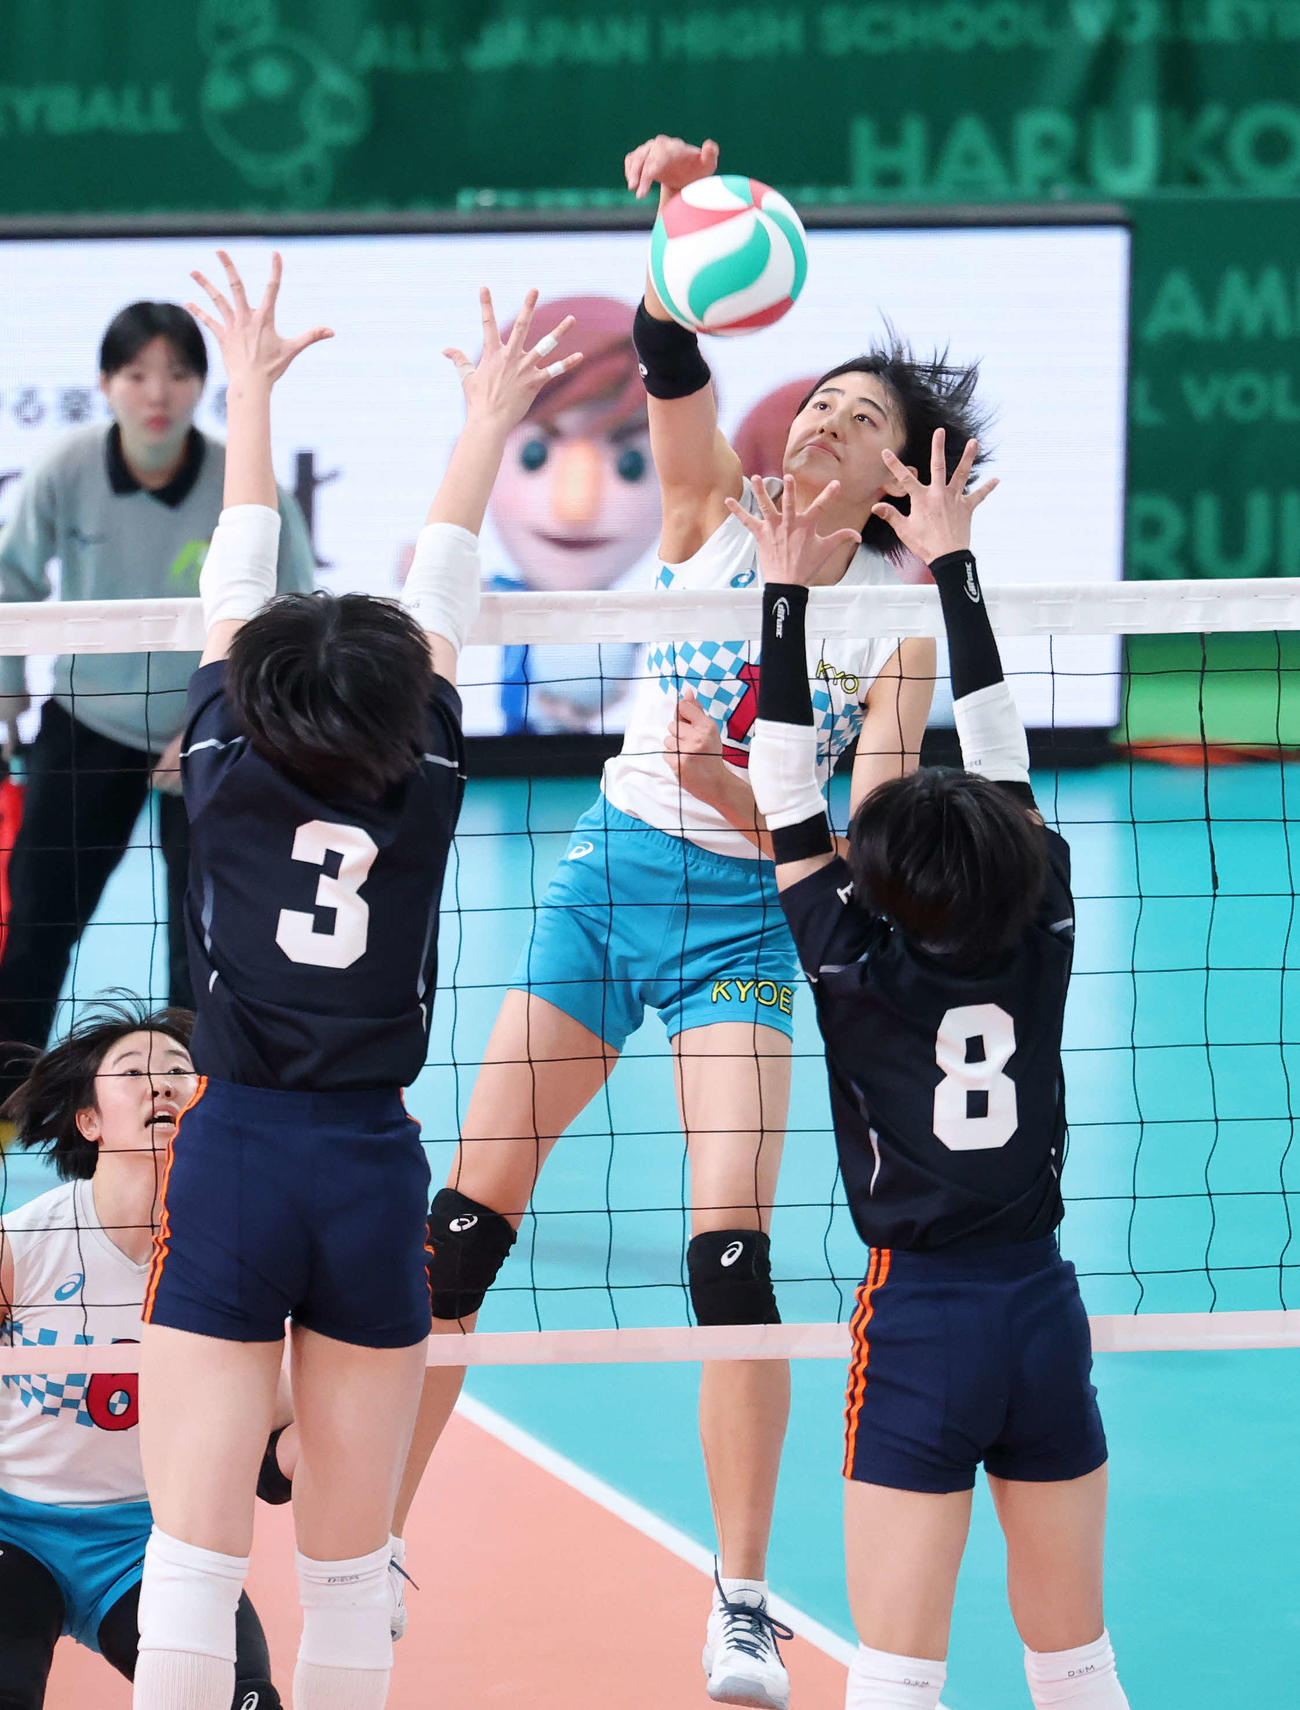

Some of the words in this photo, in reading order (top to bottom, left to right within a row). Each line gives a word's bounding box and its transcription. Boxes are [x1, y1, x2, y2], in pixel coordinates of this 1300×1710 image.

[274, 819, 380, 970] 3
[711, 978, 794, 1016] KYOE
[932, 1002, 1019, 1152] 8
